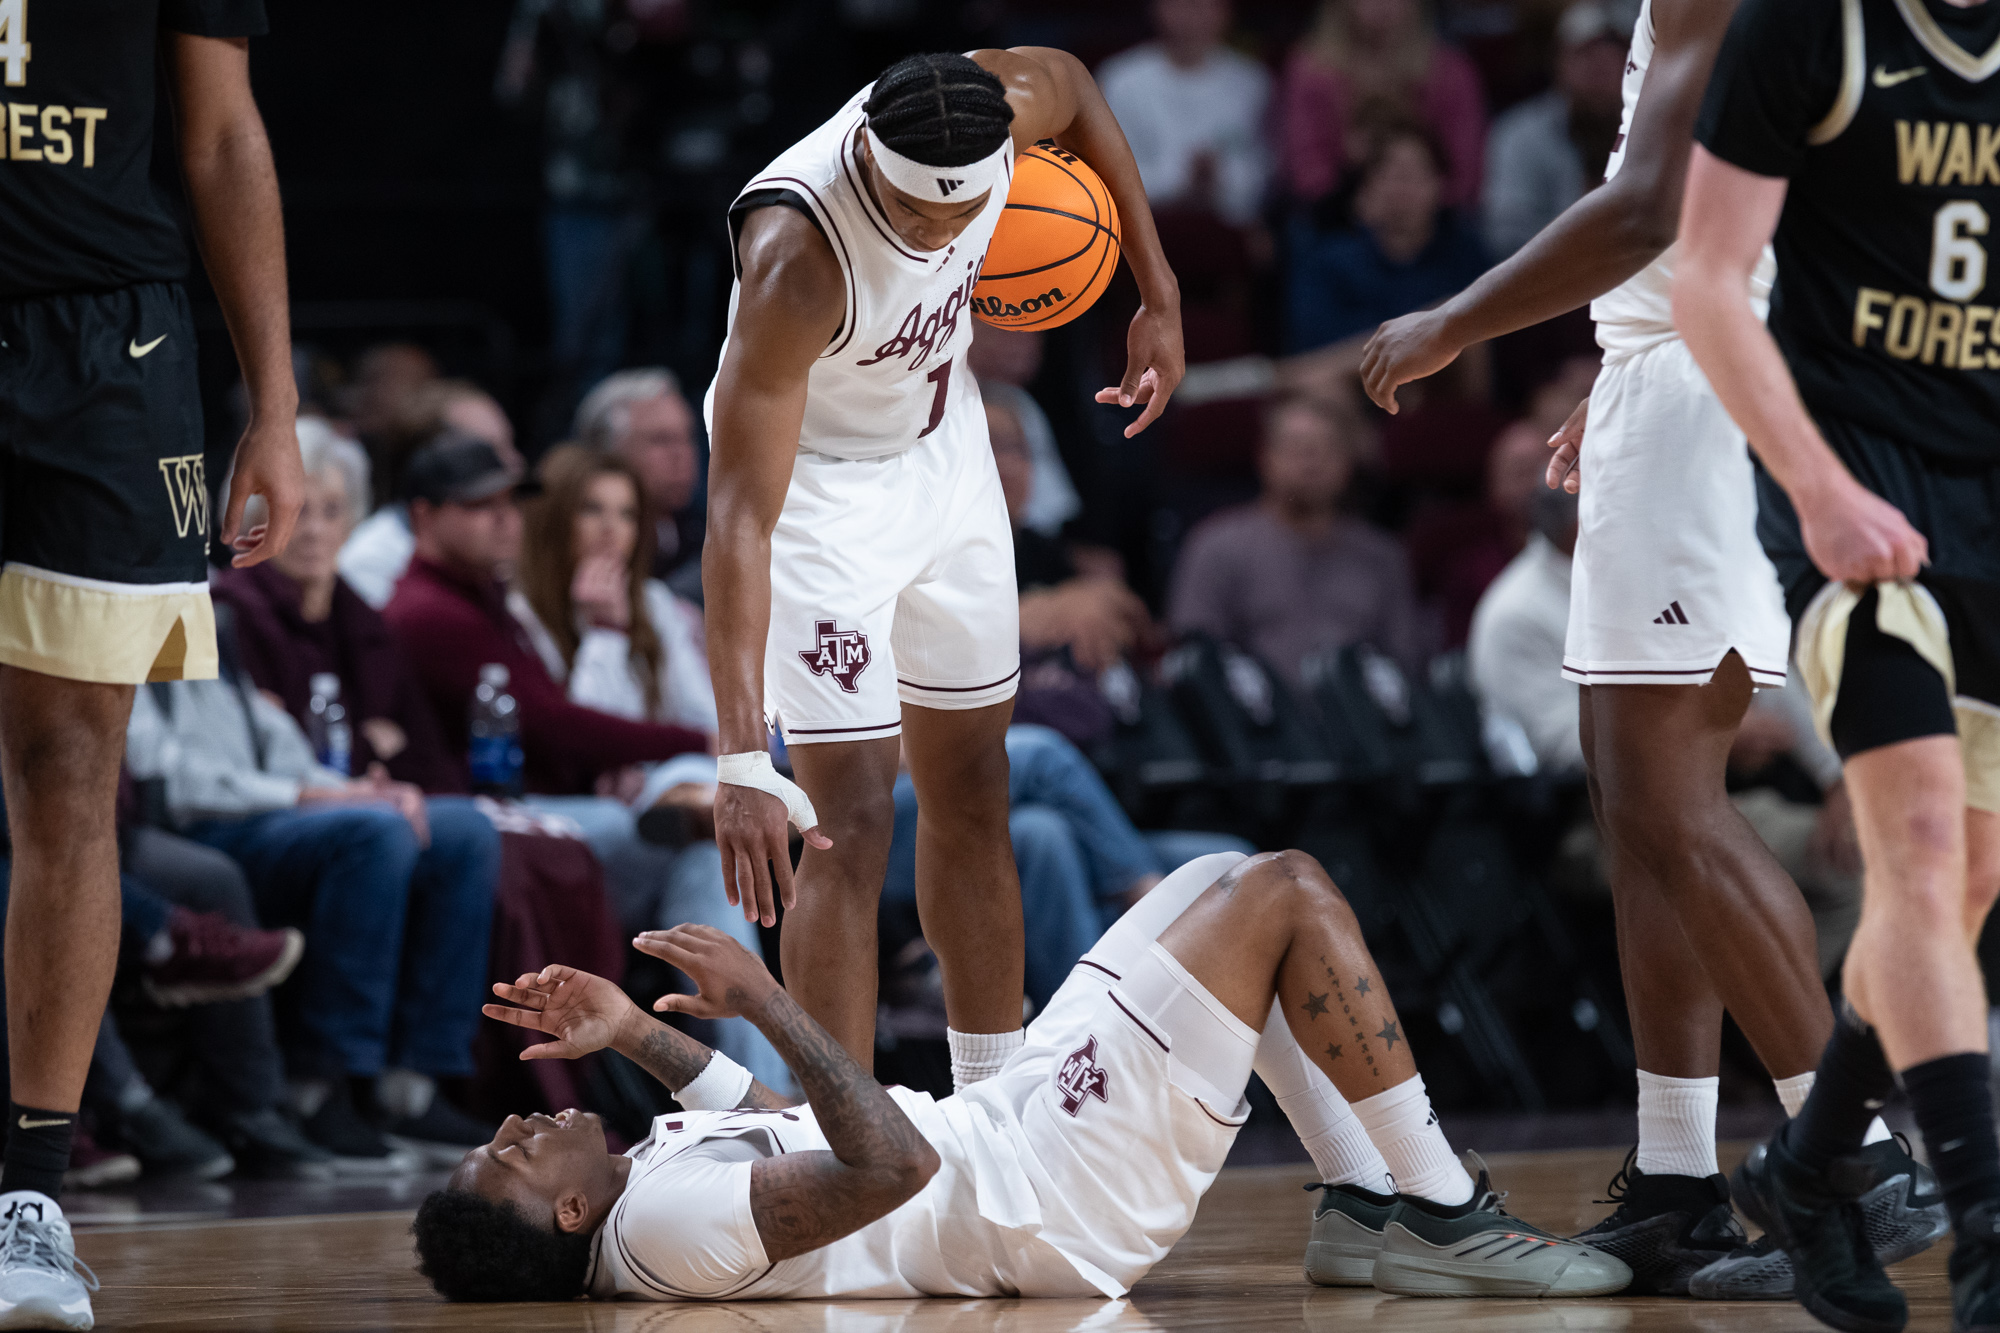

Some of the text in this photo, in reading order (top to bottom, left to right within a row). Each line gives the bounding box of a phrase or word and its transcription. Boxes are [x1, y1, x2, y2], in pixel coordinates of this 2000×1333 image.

[0, 102, 107, 168] EST
[1929, 200, 1990, 302] 6
[917, 354, 954, 439] 1
